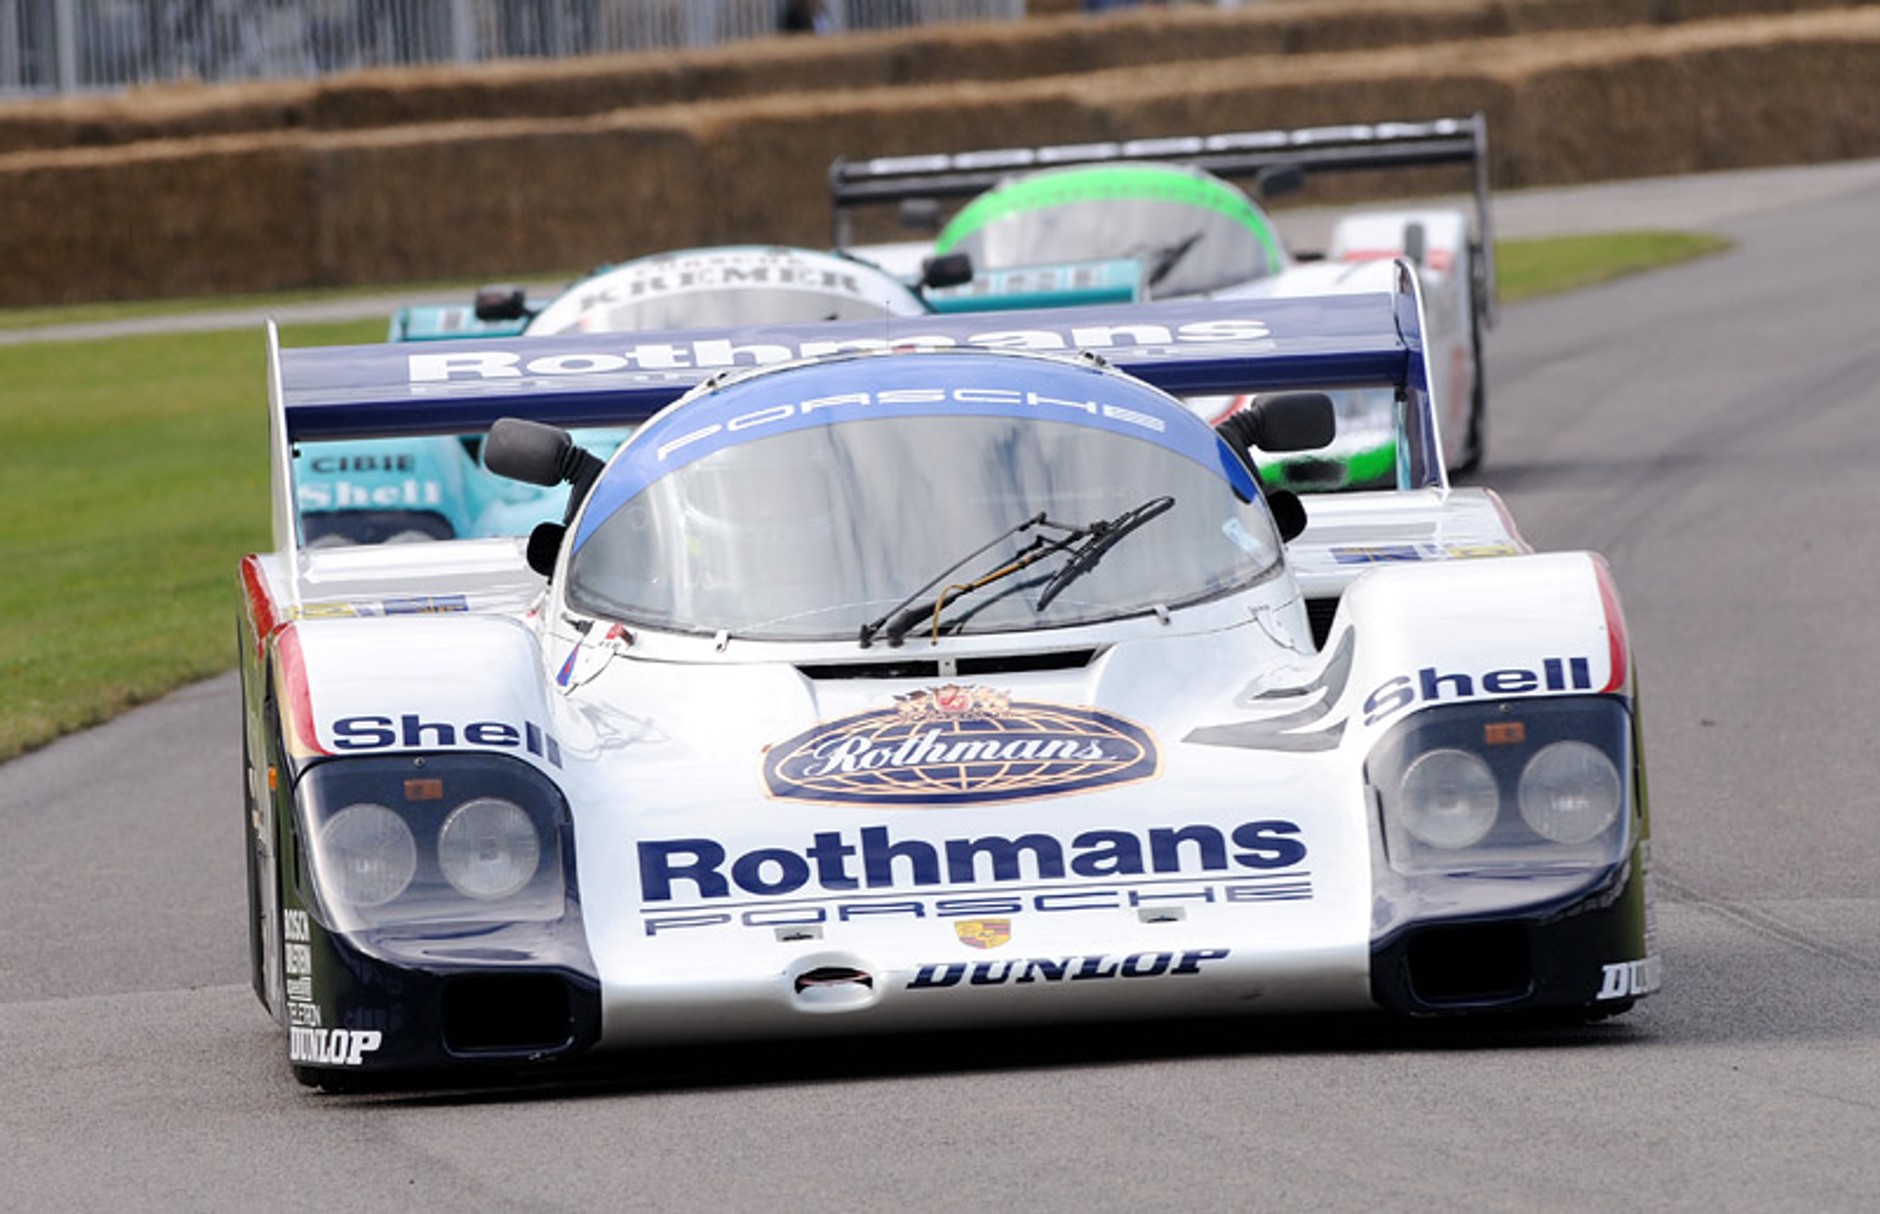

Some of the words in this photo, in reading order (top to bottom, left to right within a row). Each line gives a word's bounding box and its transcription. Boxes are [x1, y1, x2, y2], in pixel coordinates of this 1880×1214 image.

[580, 266, 859, 310] KREMER
[657, 388, 1166, 462] PORSCHE
[311, 454, 415, 474] CIBIE
[298, 478, 441, 508] Shell
[1363, 657, 1592, 727] Shell
[332, 714, 563, 769] Shell
[637, 820, 1308, 902] Rothmans
[644, 881, 1314, 936] PORSCHE
[905, 949, 1231, 989] DUNLOP
[289, 1026, 383, 1066] DUNLOP
